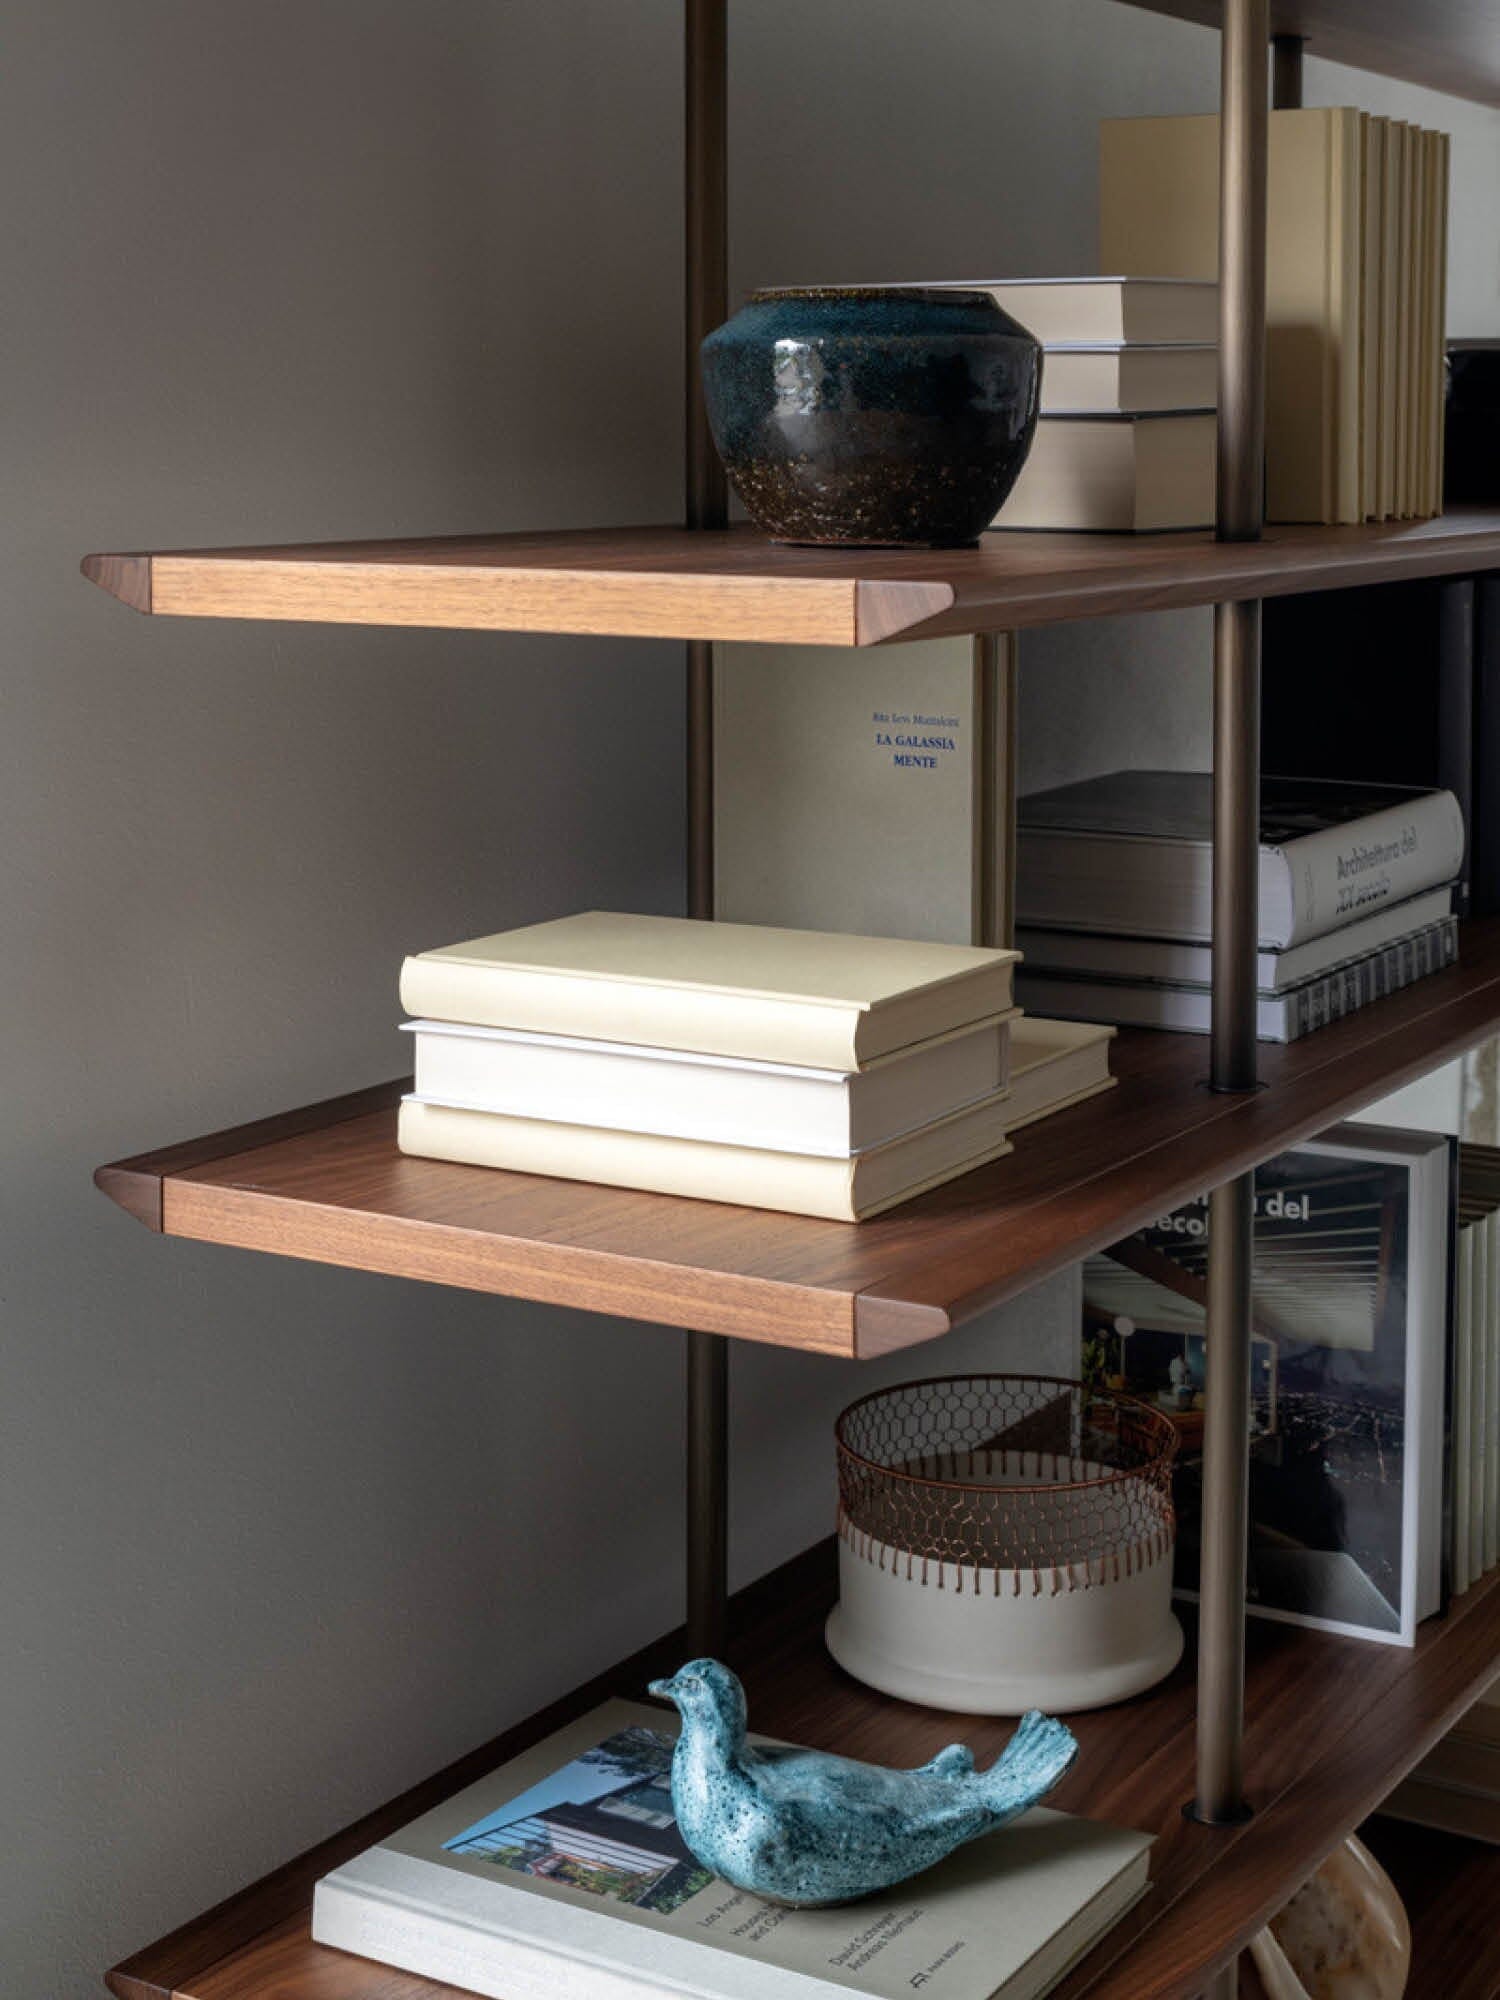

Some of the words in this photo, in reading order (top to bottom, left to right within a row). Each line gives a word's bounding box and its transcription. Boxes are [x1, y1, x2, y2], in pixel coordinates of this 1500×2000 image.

[876, 733, 892, 745] LA
[895, 735, 955, 750] GALASSIA
[894, 753, 938, 768] MENTE
[1265, 1192, 1309, 1221] del
